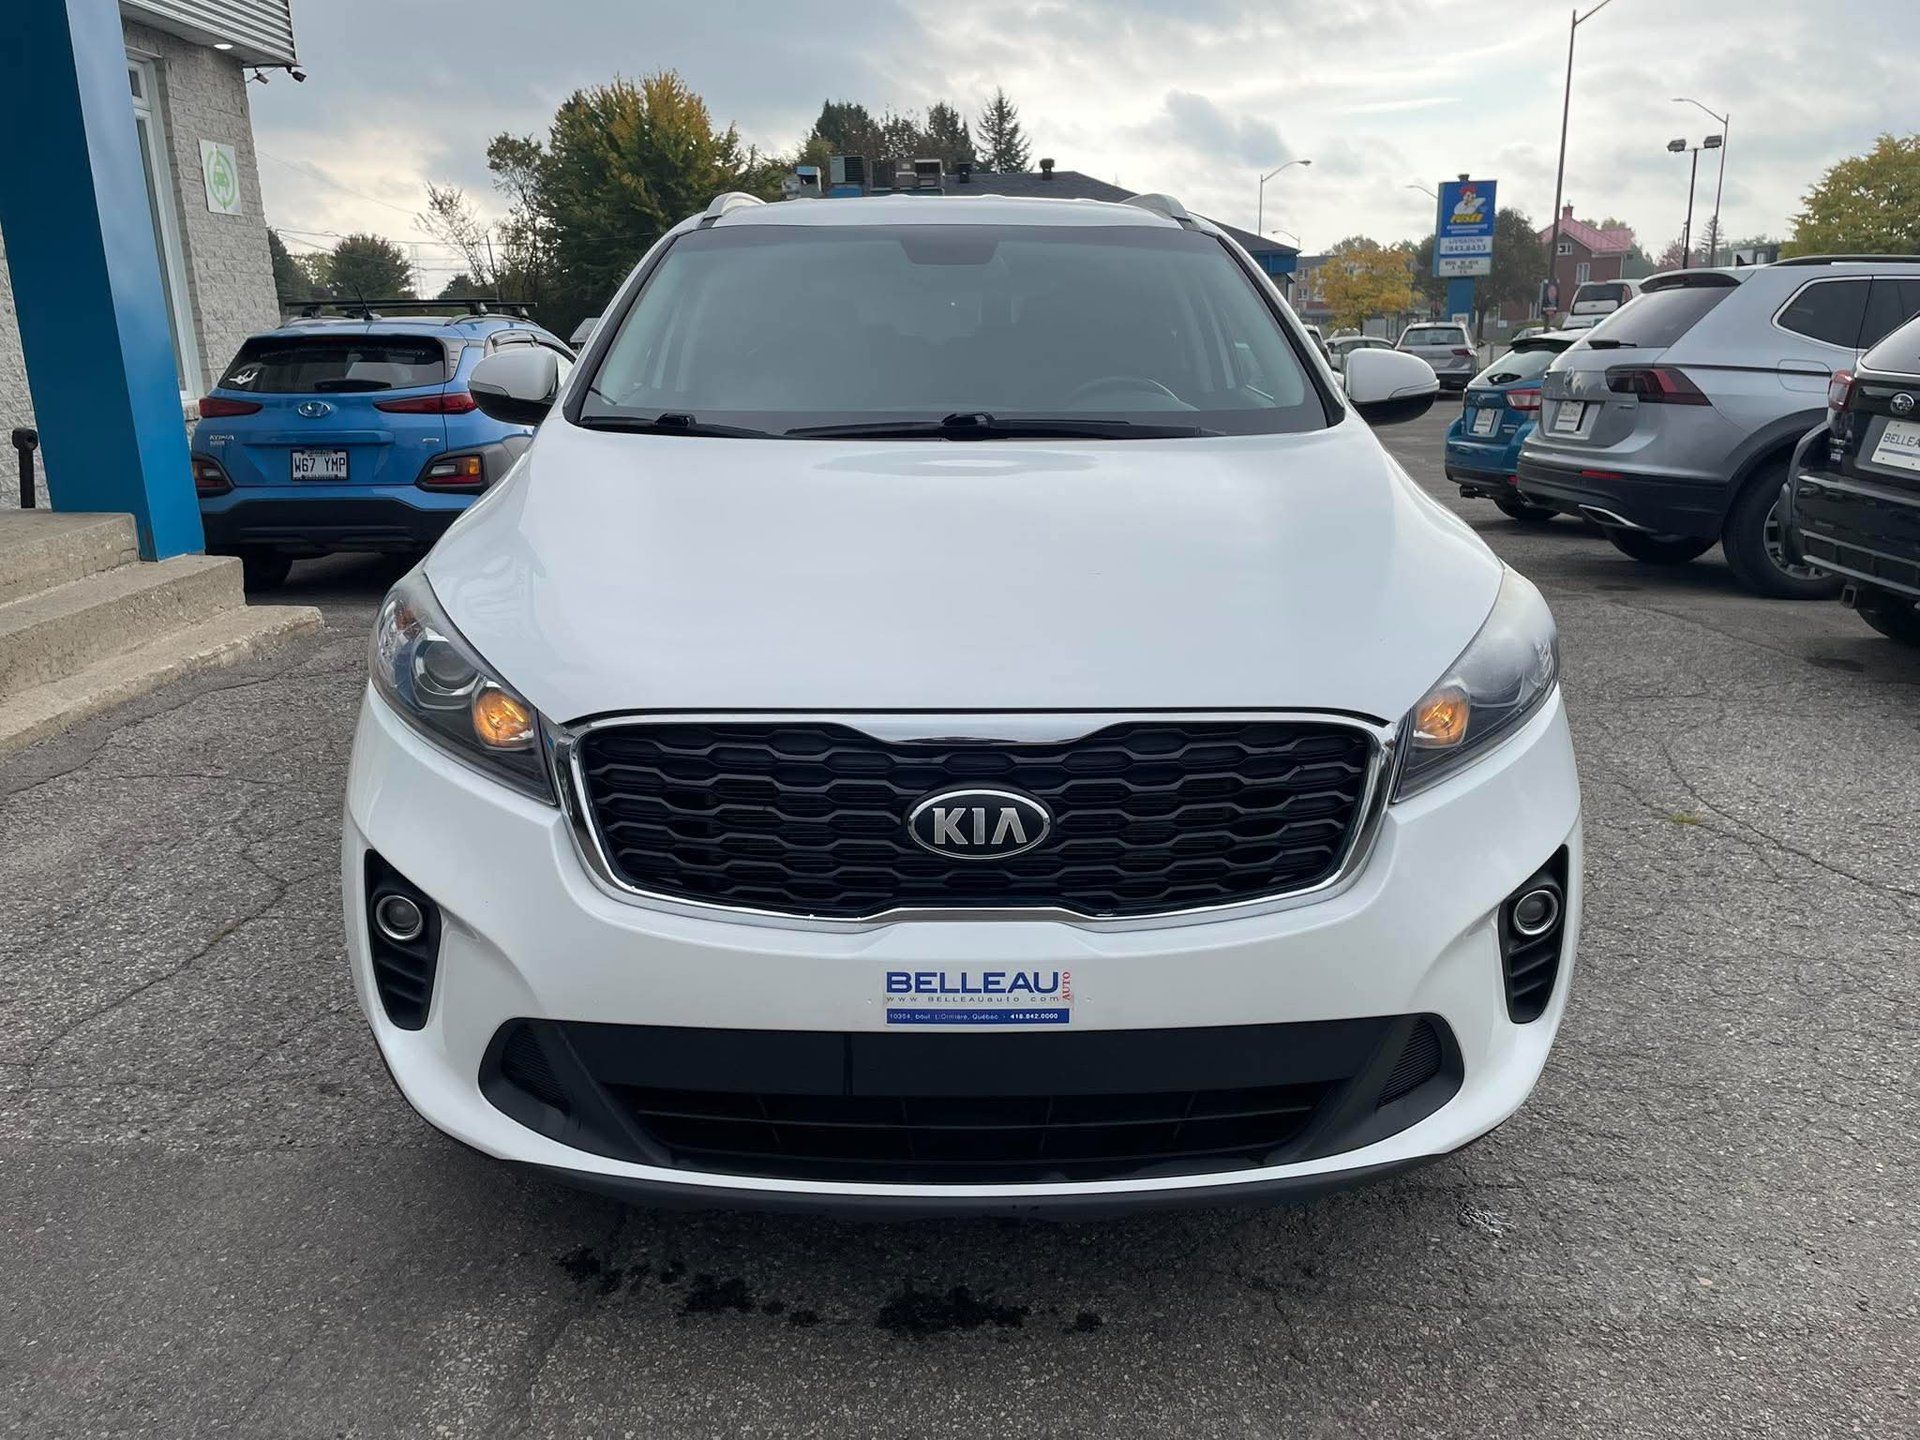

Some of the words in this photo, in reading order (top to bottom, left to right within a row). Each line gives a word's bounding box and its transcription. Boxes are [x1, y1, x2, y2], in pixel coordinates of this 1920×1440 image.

[294, 457, 316, 473] W67
[324, 457, 346, 472] YMP
[932, 807, 1028, 845] KIA
[886, 971, 1059, 994] BELLEAU
[1061, 971, 1071, 1001] AUTO
